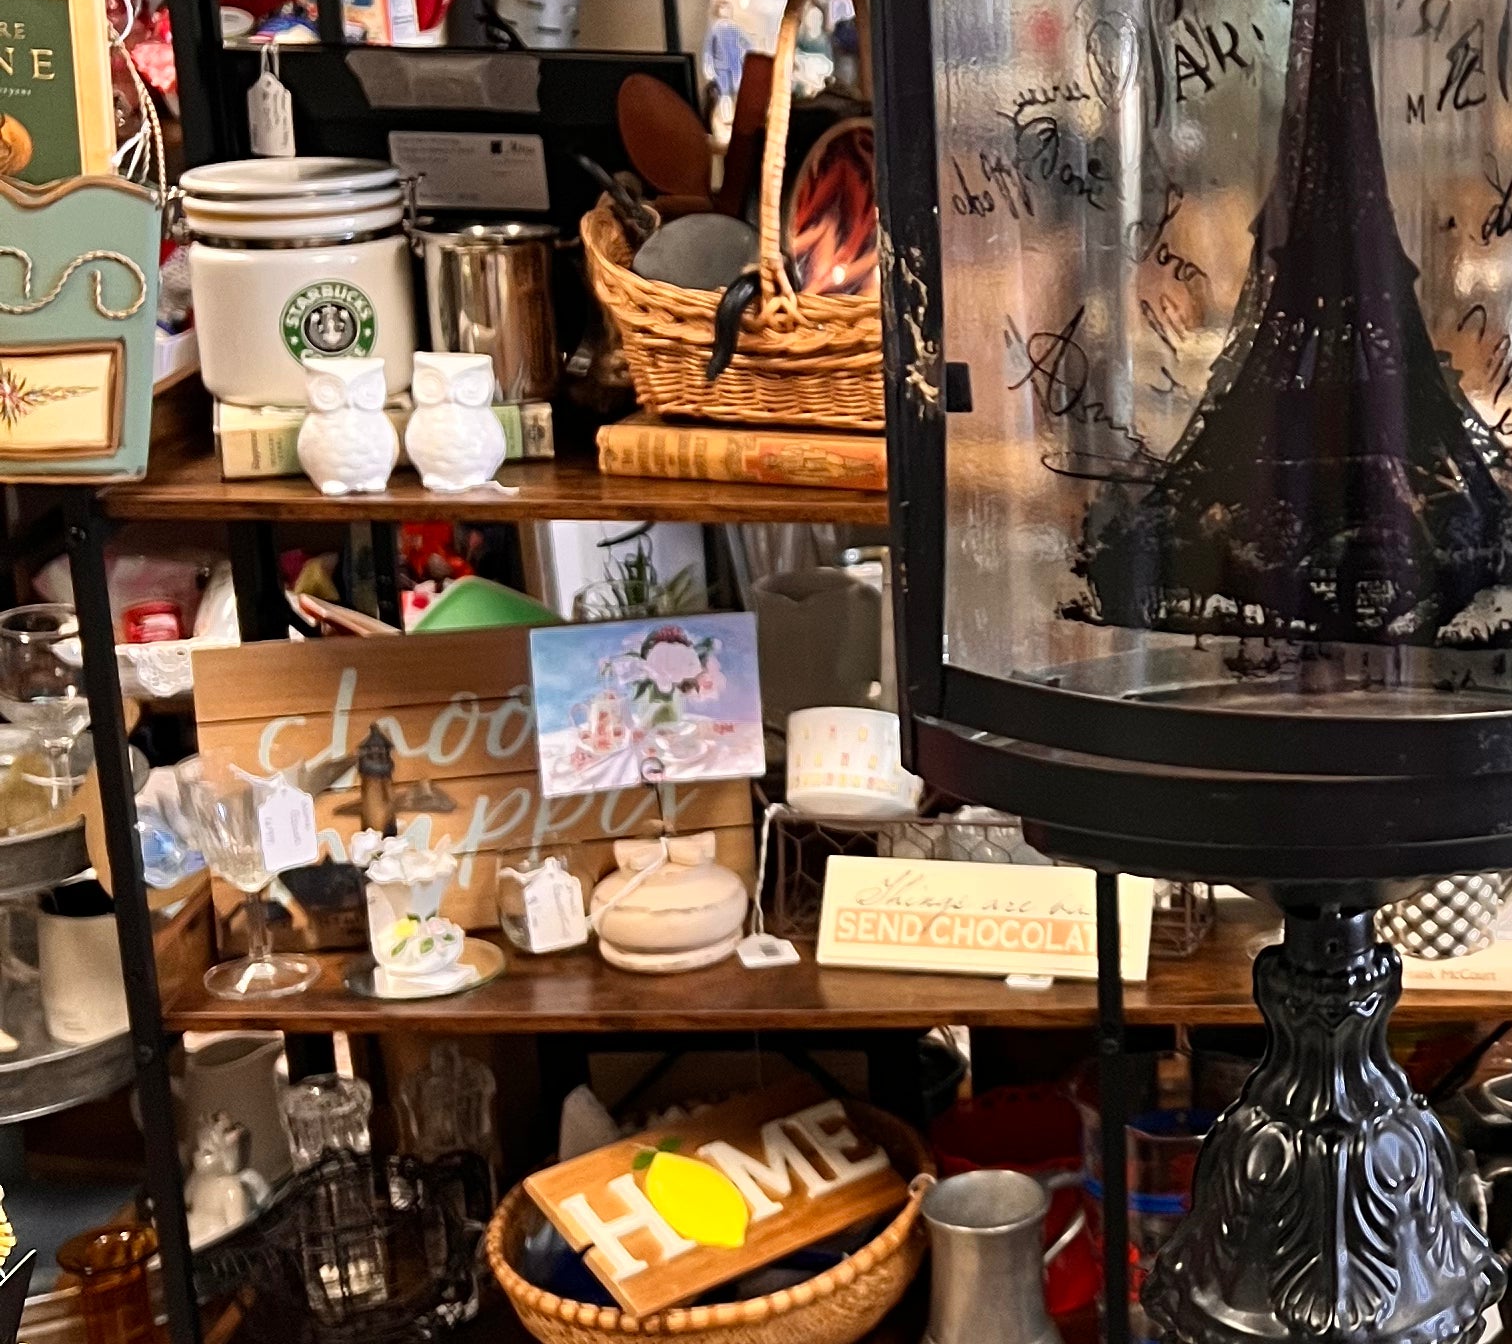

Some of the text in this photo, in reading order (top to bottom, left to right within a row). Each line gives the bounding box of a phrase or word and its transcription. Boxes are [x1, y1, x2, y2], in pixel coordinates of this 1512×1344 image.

[286, 284, 373, 329] STARBUCKS
[855, 869, 962, 926] Things
[982, 899, 1032, 914] are
[837, 910, 923, 944] SEND
[559, 1098, 891, 1282] HME
